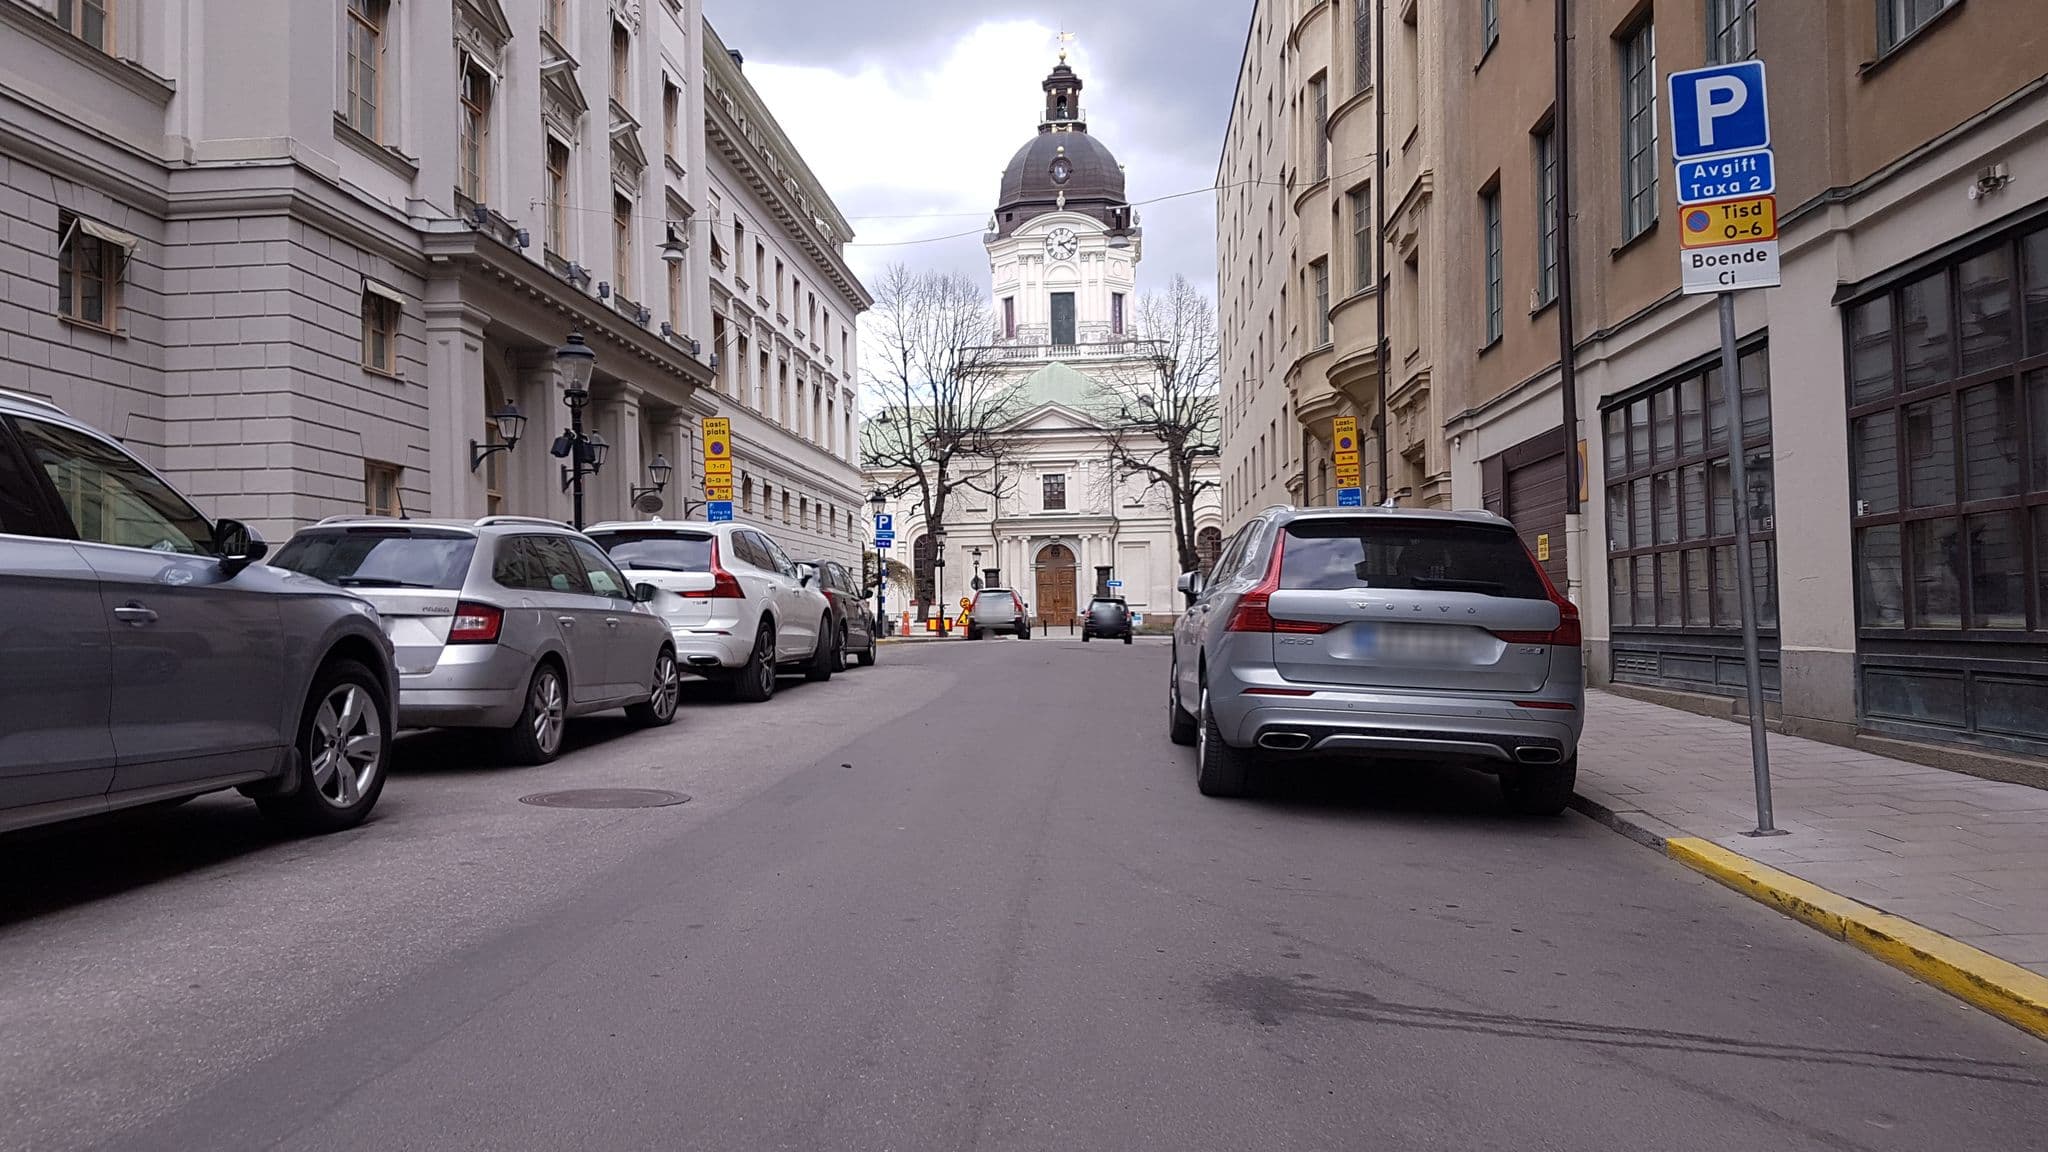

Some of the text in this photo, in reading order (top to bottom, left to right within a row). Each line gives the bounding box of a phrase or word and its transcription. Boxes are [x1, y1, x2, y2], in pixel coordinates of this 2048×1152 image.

[1695, 75, 1748, 147] P
[1694, 157, 1757, 179] Avgift
[1691, 175, 1761, 198] Taxa 2
[1721, 201, 1762, 219] Tisd
[1724, 221, 1763, 239] 0-6
[1692, 248, 1768, 268] Boende
[1718, 270, 1736, 285] Ci
[706, 428, 726, 436] plats
[879, 515, 889, 528] P
[1356, 602, 1477, 615] VOLVO
